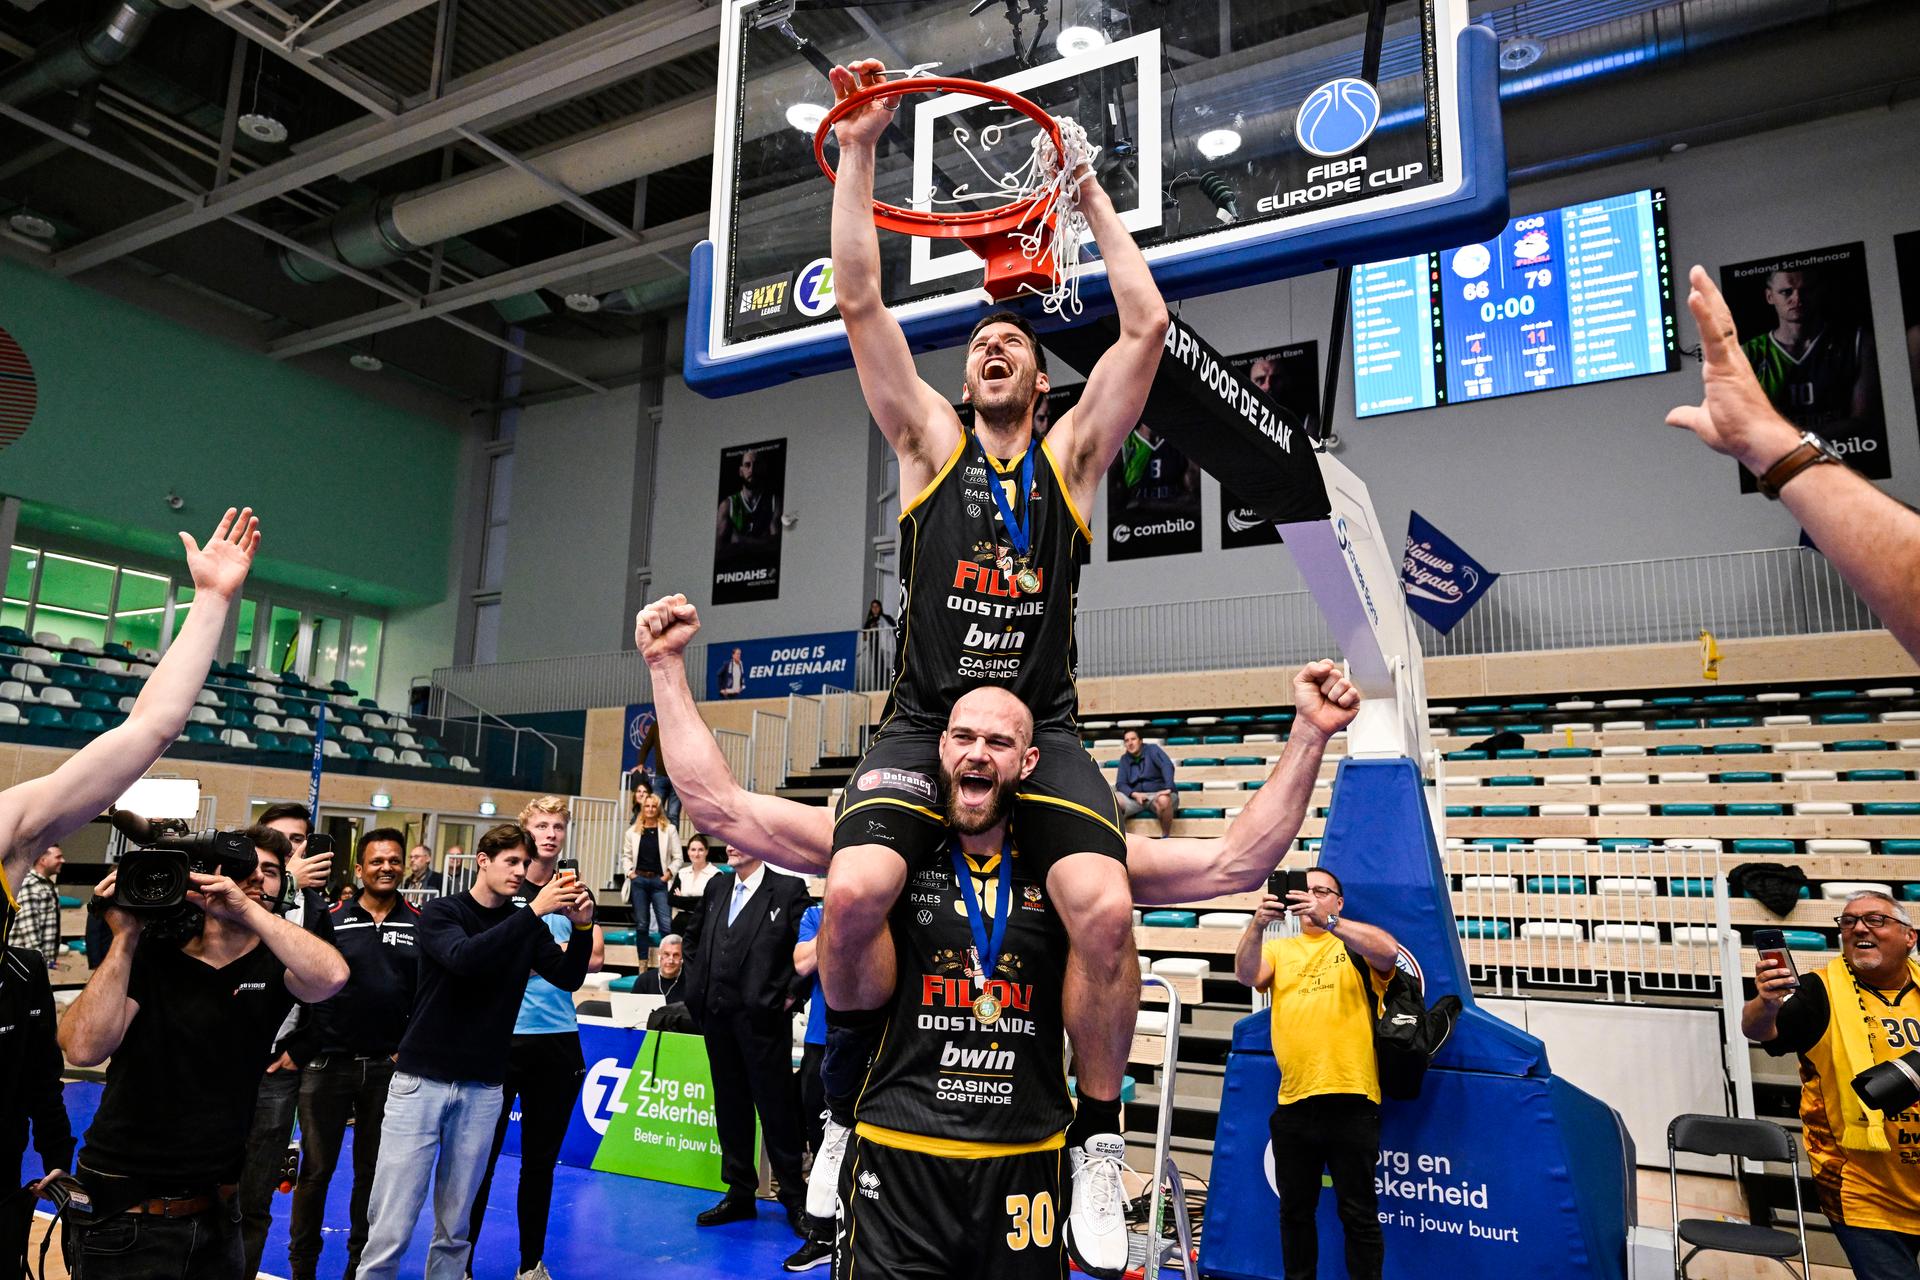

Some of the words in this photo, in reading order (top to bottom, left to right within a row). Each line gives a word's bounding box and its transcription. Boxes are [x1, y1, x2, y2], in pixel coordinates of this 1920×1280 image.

[1307, 155, 1367, 183] FIBA
[1256, 177, 1361, 212] EUROPE
[1368, 162, 1423, 187] CUP
[1657, 227, 1665, 236] 2
[1658, 240, 1666, 249] 3
[1660, 265, 1668, 274] 4
[1733, 262, 1780, 278] Roeland
[1463, 281, 1490, 301] 66
[1524, 269, 1552, 290] 79
[760, 304, 782, 317] LEAGUE
[1480, 295, 1536, 323] 0:00
[1665, 316, 1673, 325] 2
[1527, 330, 1546, 345] 11
[1666, 329, 1674, 338] 3
[1470, 341, 1482, 354] 4
[1164, 320, 1200, 371] ART
[1239, 388, 1260, 427] DE
[1258, 407, 1293, 454] ZAAK
[1832, 437, 1877, 454] bilo
[964, 489, 990, 500] RAES
[1133, 518, 1196, 537] combilo
[716, 569, 767, 584] PINDAHS
[953, 560, 1043, 598] FIL
[1403, 557, 1463, 597] Brigade
[947, 595, 1044, 619] OOSTENDE
[963, 623, 1025, 649] bwin
[771, 648, 809, 662] DOUG
[812, 646, 825, 658] IS
[959, 656, 1020, 670] CASINO
[750, 664, 774, 678] EEN
[776, 658, 846, 677] LEIENAAR!
[958, 668, 1018, 678] OOSTENDE
[911, 893, 941, 904] RAES
[954, 875, 1014, 919] 30
[1334, 954, 1346, 963] 13
[922, 974, 1033, 1012] FILOU
[918, 1014, 1036, 1036] OOSTENDE
[1880, 1017, 1920, 1048] 30
[940, 1041, 1015, 1070] bwin
[639, 1070, 680, 1101] Zorg
[683, 1082, 705, 1099] en
[937, 1078, 1013, 1094] CASINO
[936, 1091, 1012, 1104] OOSTENDE
[636, 1096, 718, 1127] Zekerhei
[634, 1127, 663, 1145] Beter
[666, 1132, 676, 1147] in
[678, 1134, 708, 1152] jouw
[1418, 1155, 1450, 1175] en
[1374, 1176, 1488, 1209] ekerheid
[1006, 1191, 1055, 1250] 30
[1400, 1210, 1415, 1227] in
[1420, 1213, 1463, 1235] jouw
[1469, 1220, 1519, 1243] buurt
